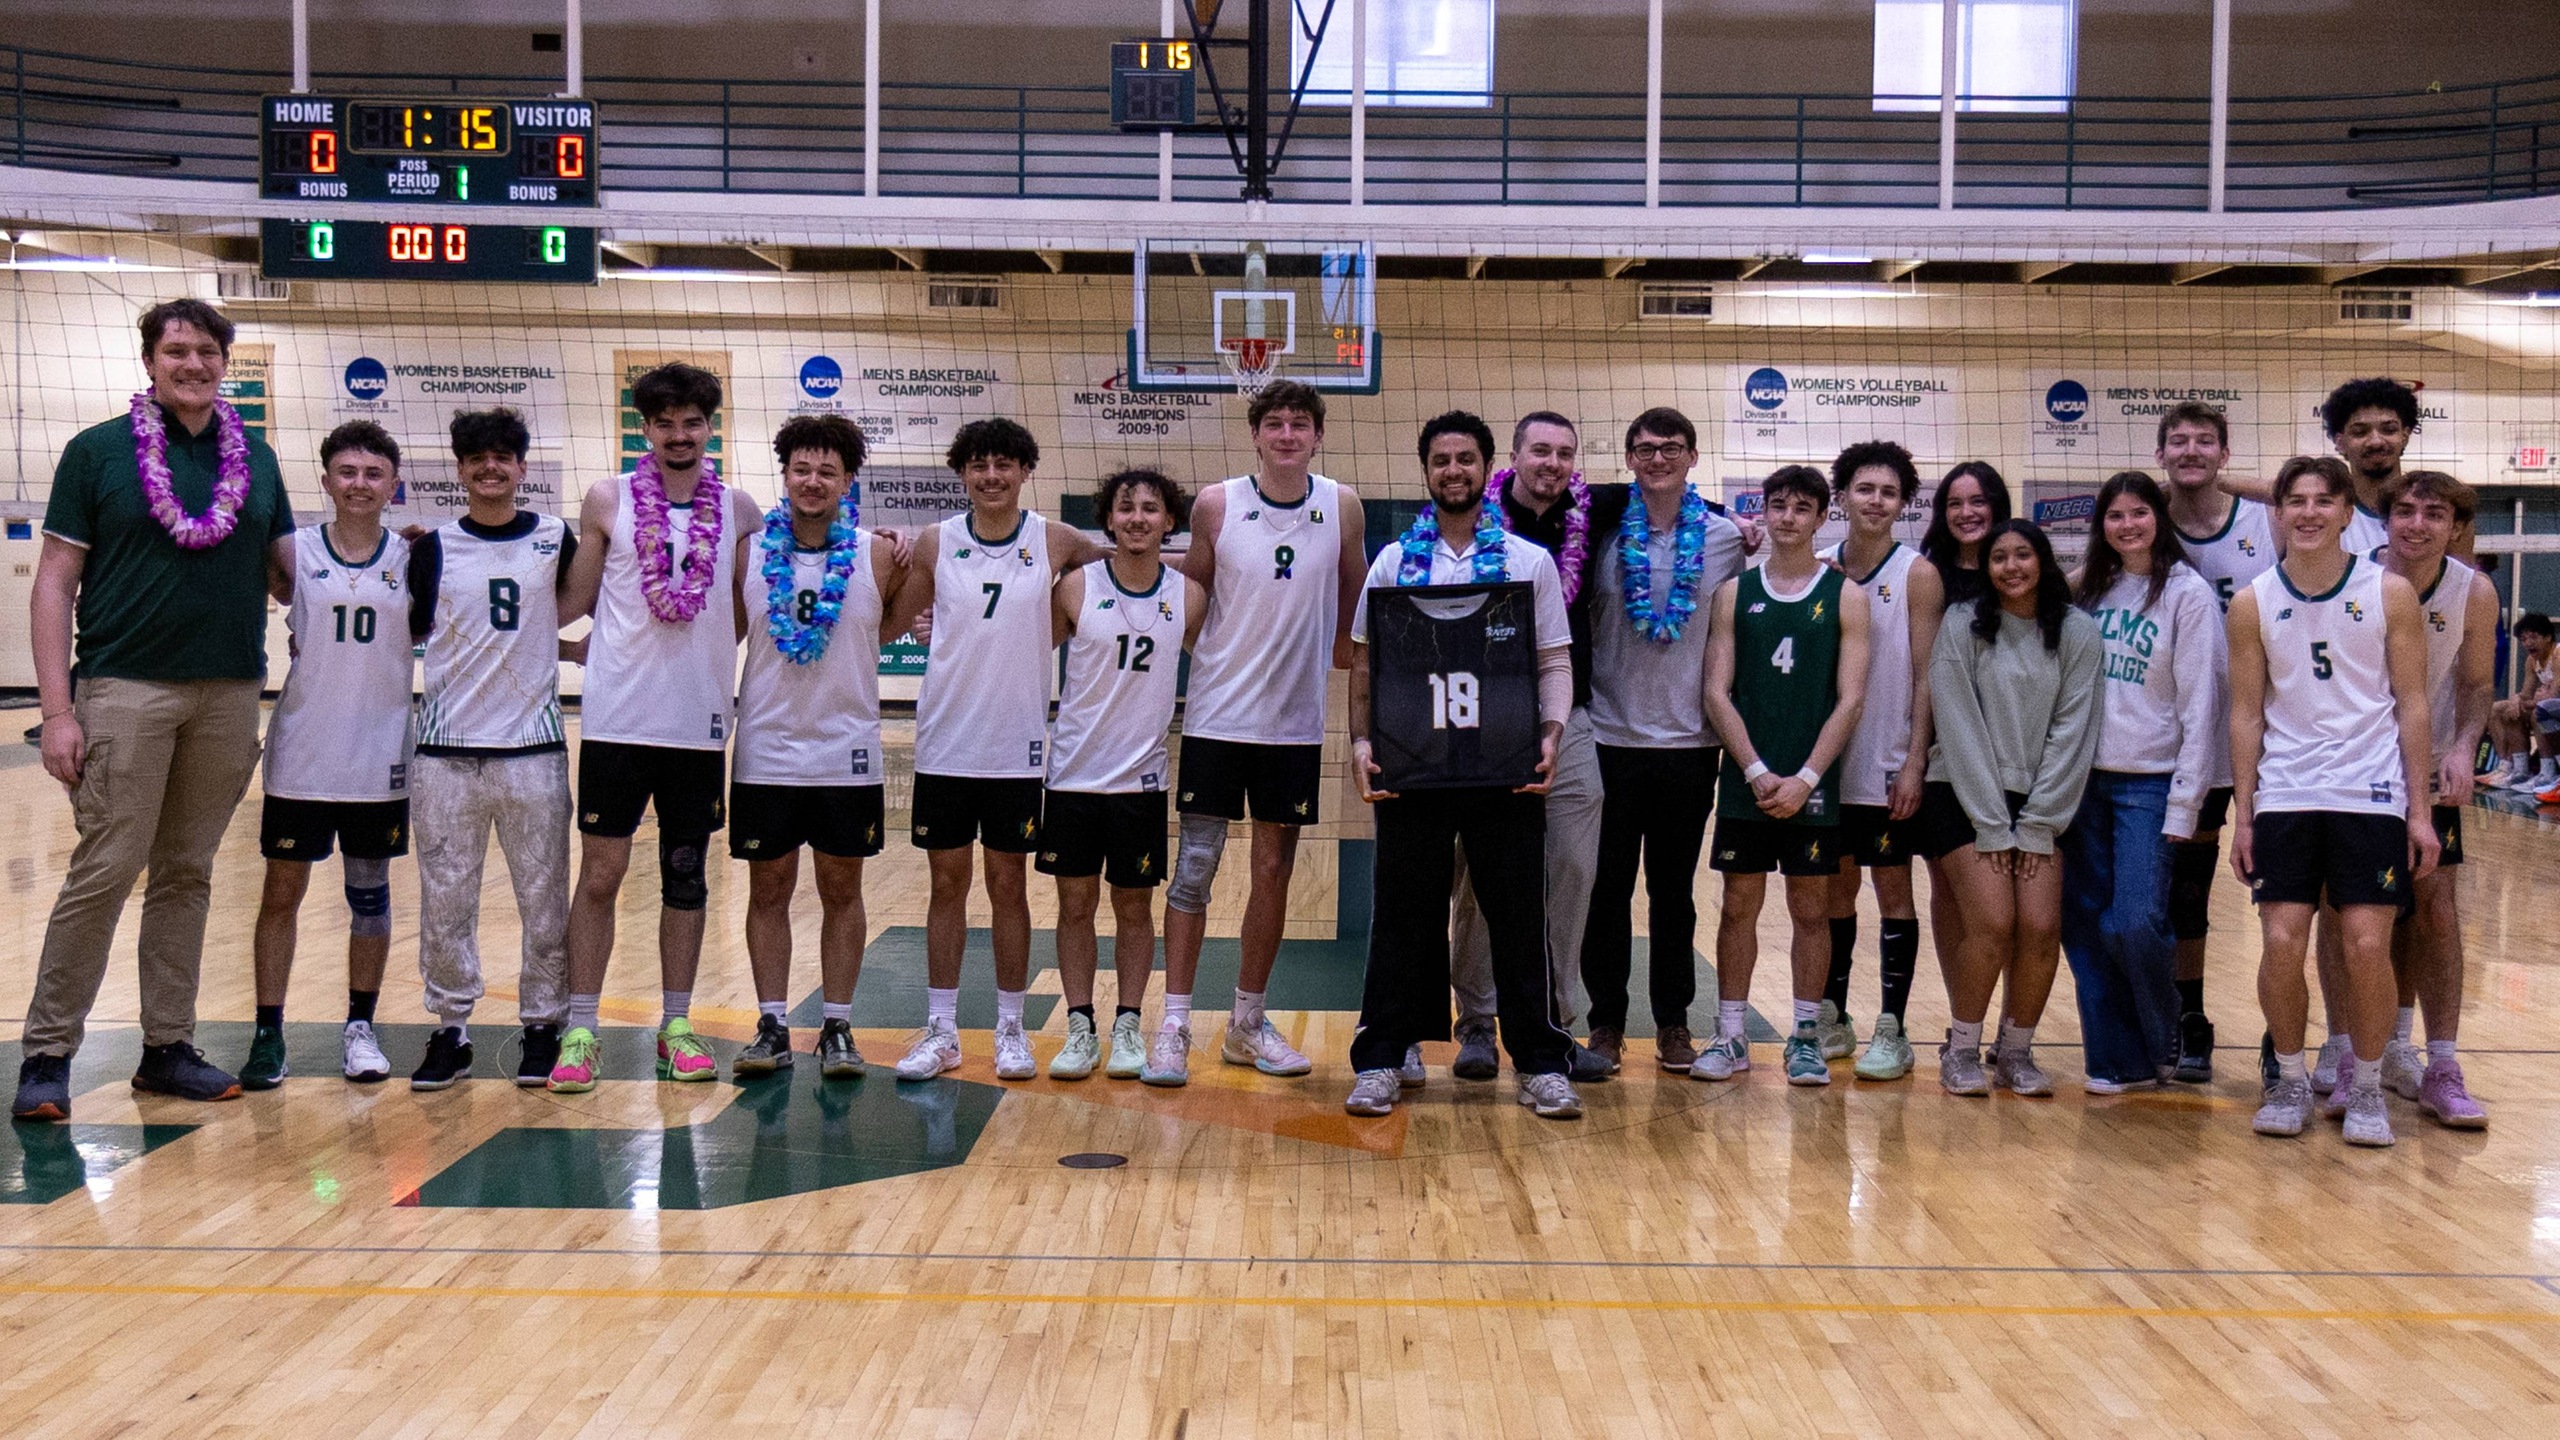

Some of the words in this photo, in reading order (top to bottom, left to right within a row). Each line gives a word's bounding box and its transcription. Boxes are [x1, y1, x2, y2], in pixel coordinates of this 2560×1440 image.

[1167, 42, 1191, 70] 15
[275, 103, 334, 122] HOME
[515, 106, 592, 127] VISITOR
[310, 130, 337, 173] 0
[557, 135, 584, 177] 0
[400, 160, 428, 171] POSS
[388, 173, 440, 188] PERIOD
[457, 165, 468, 200] 1
[300, 182, 348, 197] BONUS
[509, 186, 557, 201] BONUS
[312, 224, 334, 260] 0
[545, 227, 566, 263] 0
[228, 359, 266, 367] KETBALL
[393, 365, 458, 377] WOMEN'S
[463, 366, 555, 379] BASKETBALL
[863, 369, 904, 380] MEN'S
[909, 370, 1000, 381] BASKETBALL
[350, 378, 387, 390] NCAA
[421, 382, 526, 394] CHAMPIONSHIP
[805, 377, 841, 388] NCAA
[1791, 379, 1855, 390] WOMEN'S
[1860, 379, 1948, 392] VOLLEYBALL
[879, 385, 984, 397] CHAMPIONSHIP
[1750, 388, 1786, 400] NCAA
[2107, 388, 2148, 400] MEN'S
[2153, 388, 2241, 401] VOLLEYBALL
[800, 400, 832, 409] Division
[1074, 393, 1116, 405] MEN'S
[1121, 394, 1212, 406] BASKETBALL
[1816, 394, 1921, 407] CHAMPIONSHIP
[2051, 401, 2087, 411] NCAA
[857, 417, 893, 425] 2007-08
[1102, 408, 1185, 421] CHAMPIONS
[1745, 411, 1777, 419] Division
[862, 427, 893, 435] 008-09
[1118, 423, 1169, 435] 2009-10
[2045, 422, 2079, 430] Division
[1757, 429, 1776, 437] 2017
[2056, 439, 2076, 447] 2012
[2521, 449, 2545, 466] EXIT
[411, 481, 468, 492] WOMEN'S
[869, 481, 911, 493] MEN'S
[915, 482, 967, 494] BASKET
[489, 577, 520, 631] 8
[797, 589, 818, 625] 8
[982, 583, 1003, 619] 7
[333, 605, 376, 643] 10
[2095, 608, 2158, 658] LMS
[1117, 635, 1155, 672] 12
[1771, 637, 1794, 674] 4
[2311, 641, 2333, 681] 5
[1429, 672, 1479, 729] 18
